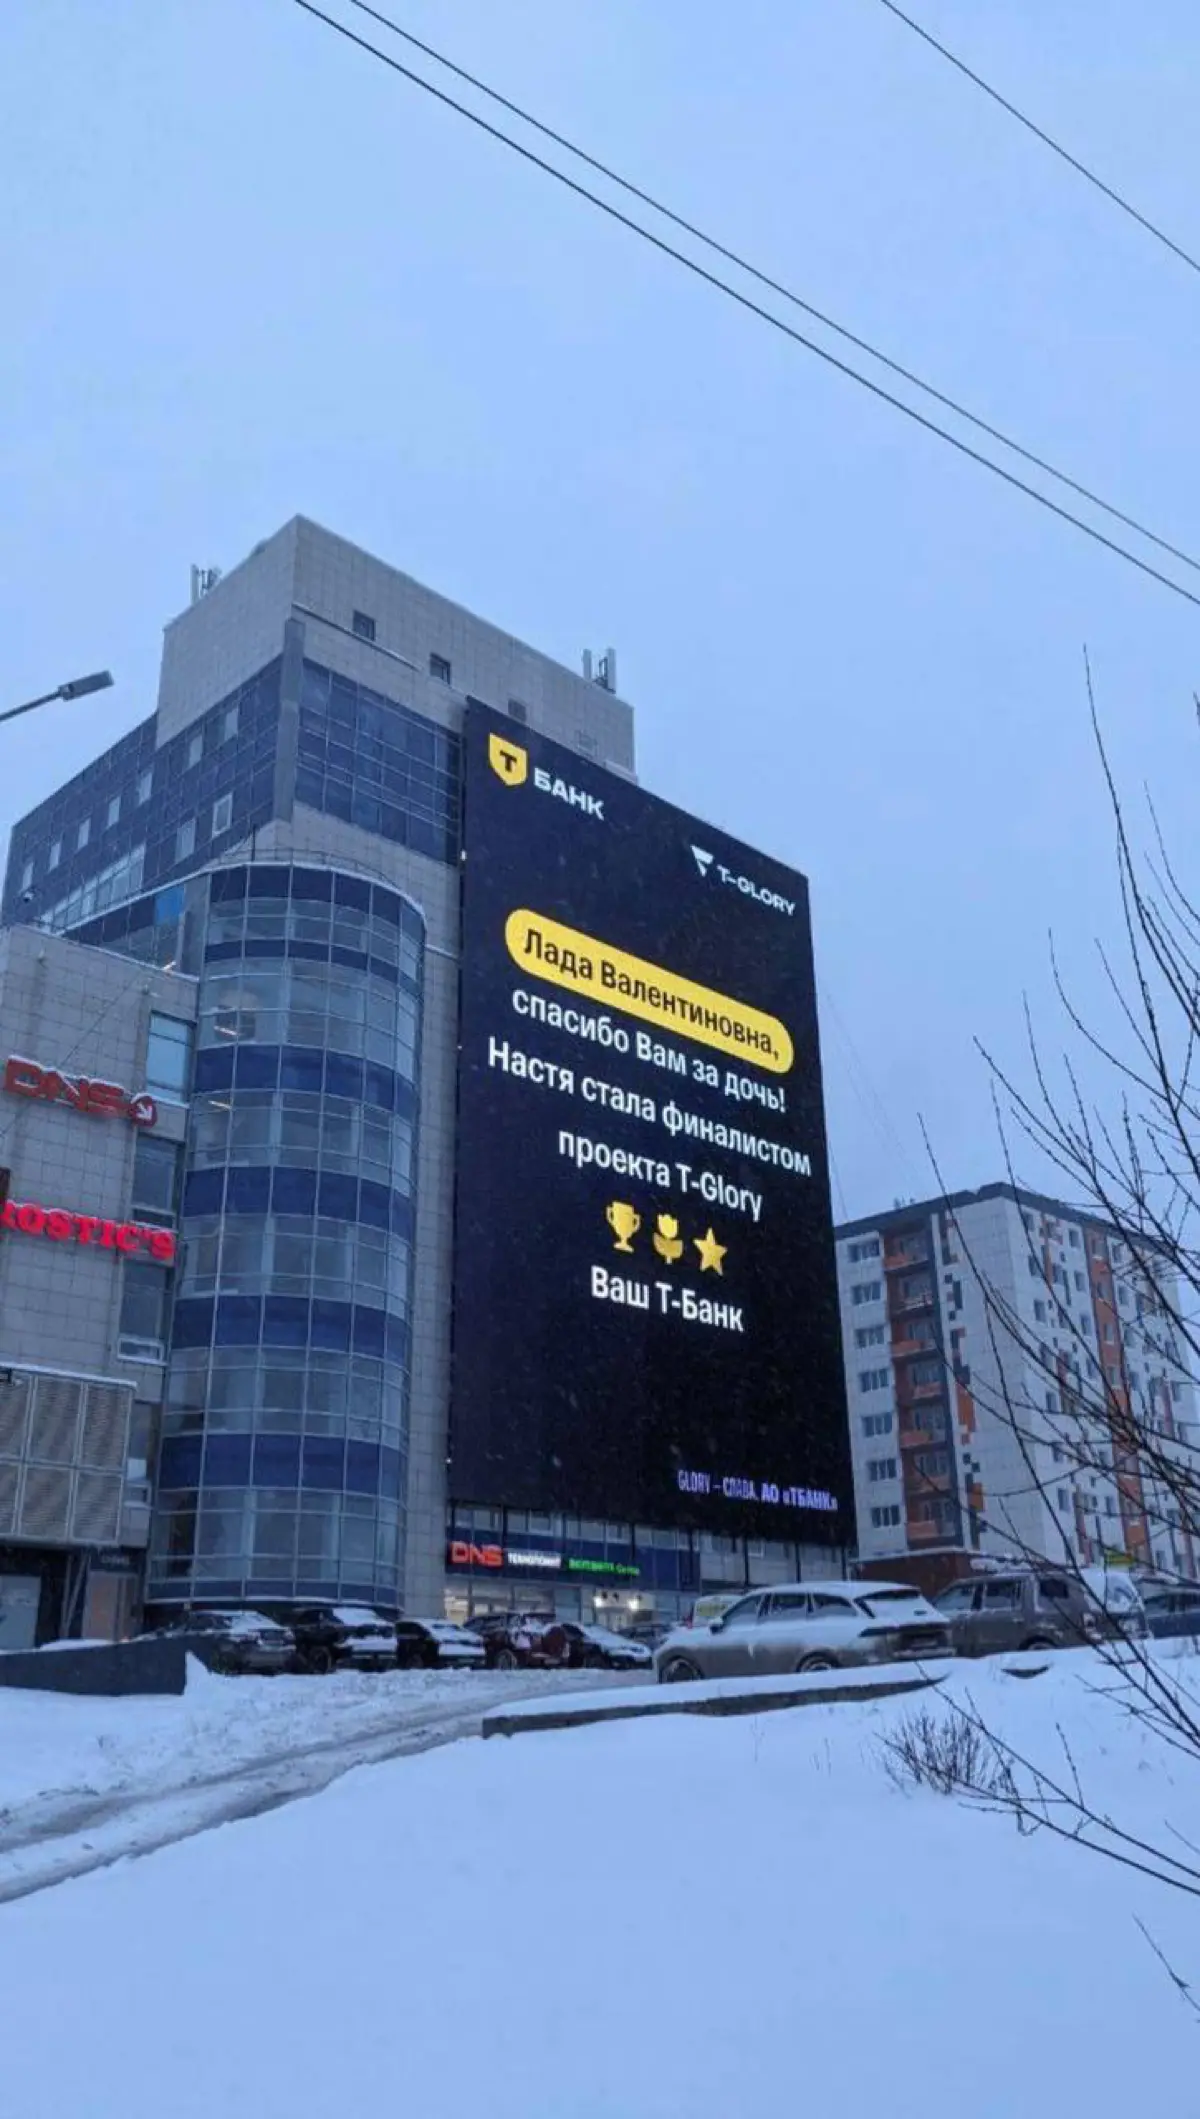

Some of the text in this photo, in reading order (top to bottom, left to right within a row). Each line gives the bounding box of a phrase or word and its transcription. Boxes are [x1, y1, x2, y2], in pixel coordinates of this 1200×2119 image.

[534, 768, 604, 820] БАНК
[717, 864, 796, 916] T-GLORY
[525, 928, 780, 1061] Лада Валентиновна,
[512, 988, 787, 1113] спасибо Вам за дочь!
[6, 1055, 127, 1117] DNS
[488, 1036, 812, 1177] Настя стала финалистом
[558, 1130, 764, 1222] проекта T-Glory
[591, 1265, 744, 1332] Ваш Т-Банк
[677, 1469, 711, 1494] GLORY
[761, 1482, 780, 1504] АО
[451, 1540, 504, 1567] DNS
